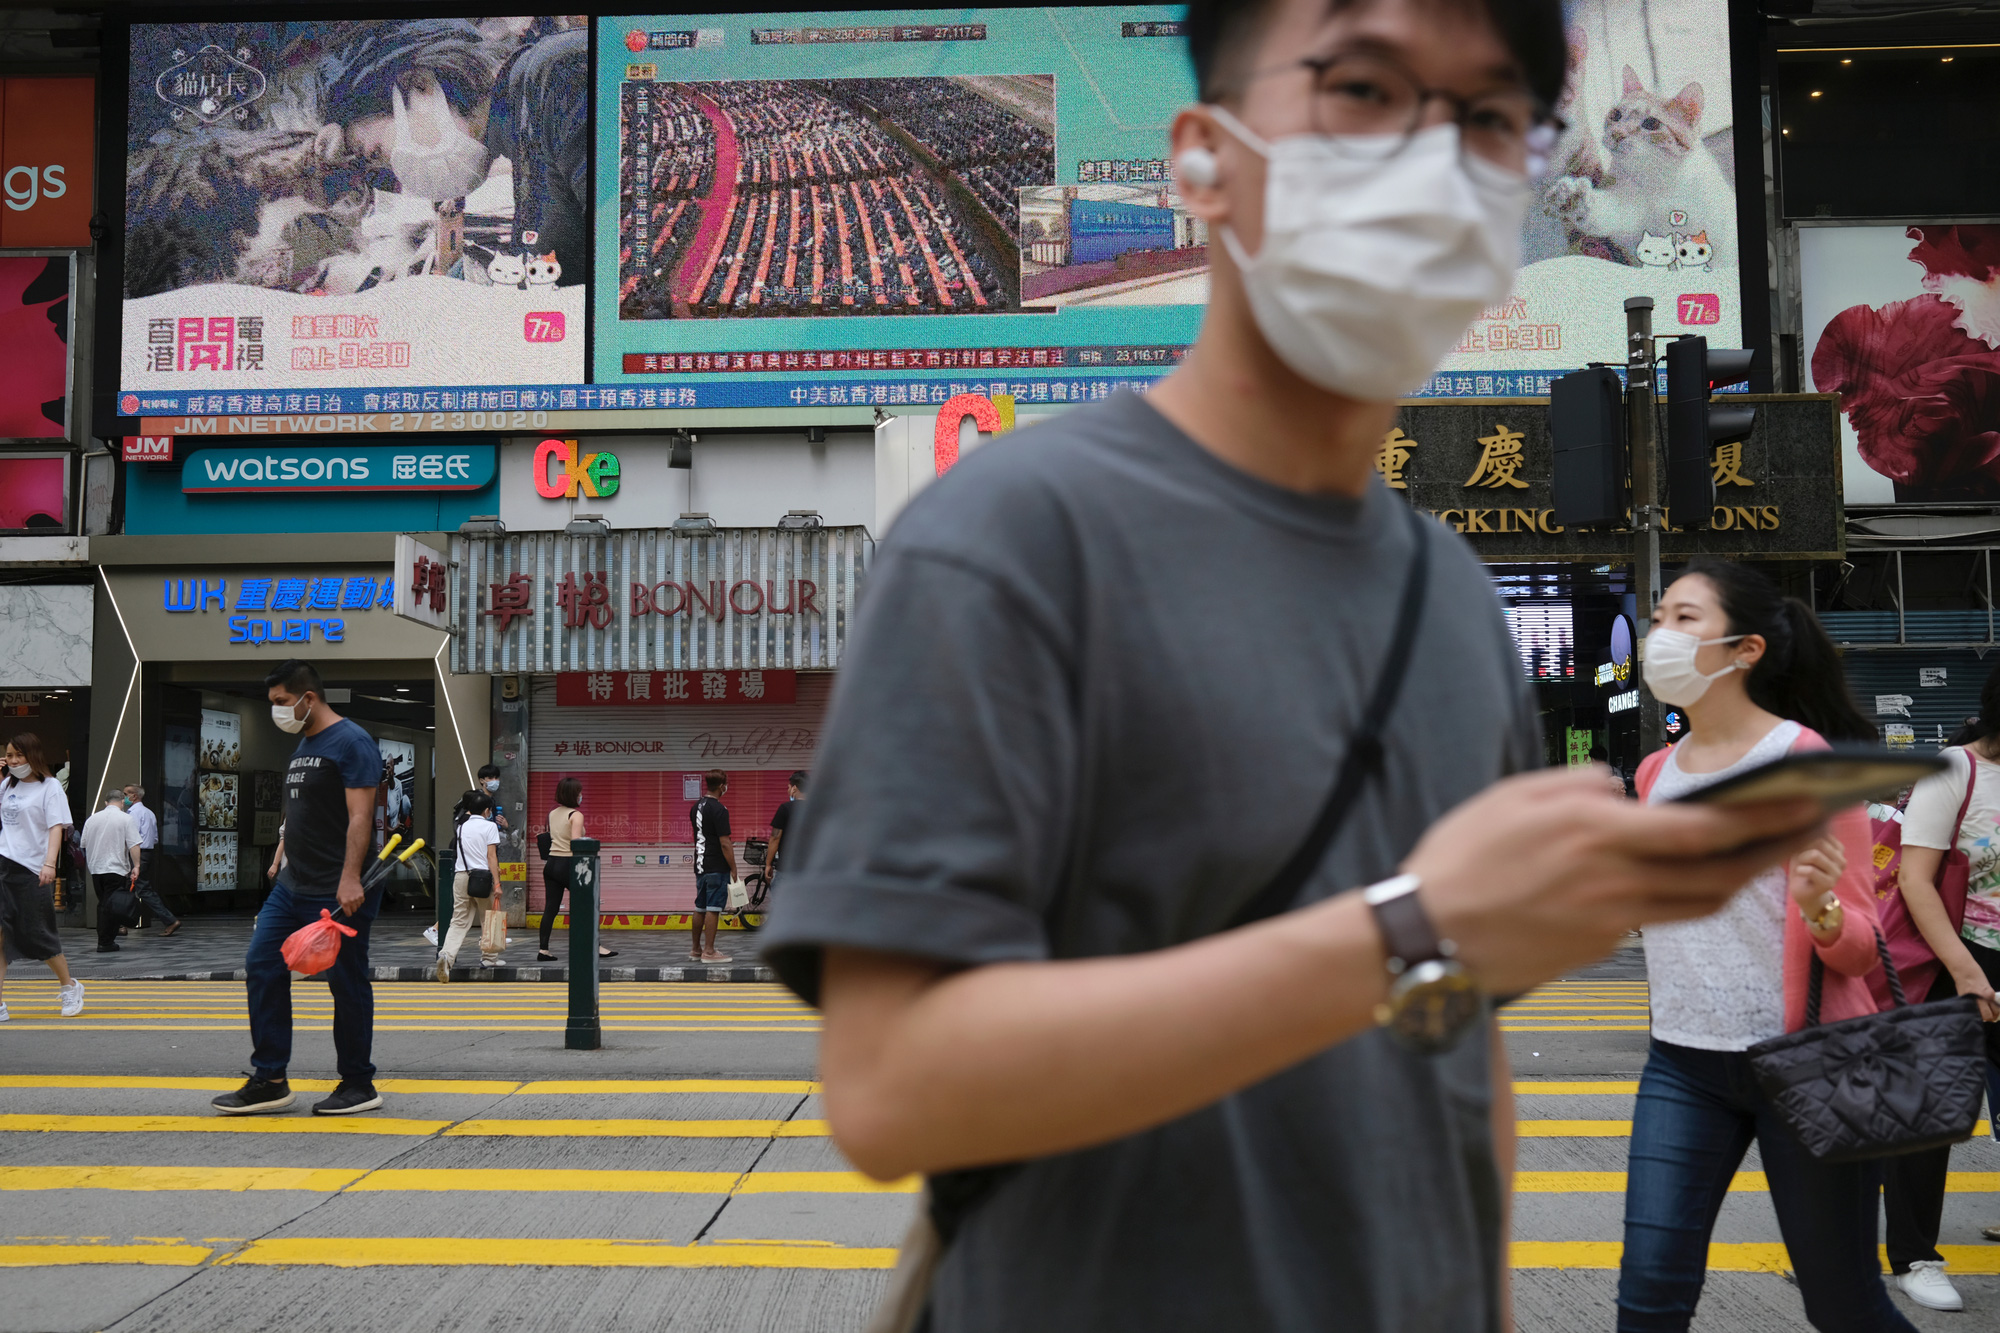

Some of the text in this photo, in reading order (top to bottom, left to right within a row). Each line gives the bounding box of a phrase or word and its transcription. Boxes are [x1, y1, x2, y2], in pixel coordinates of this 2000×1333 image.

[3, 164, 67, 212] gs
[338, 341, 411, 369] 9:30
[174, 411, 548, 435] JM NETWORK 27230020
[125, 454, 168, 462] NETWORK
[126, 437, 170, 453] JM
[204, 454, 470, 481] watsons 屈臣氏
[533, 439, 620, 498] Cke
[163, 578, 227, 612] WK
[629, 577, 821, 623] BONJOUR
[227, 614, 345, 645] Square
[587, 671, 765, 701] 特價批發場
[595, 740, 665, 754] BONJOUR
[286, 771, 307, 784] EAGLE
